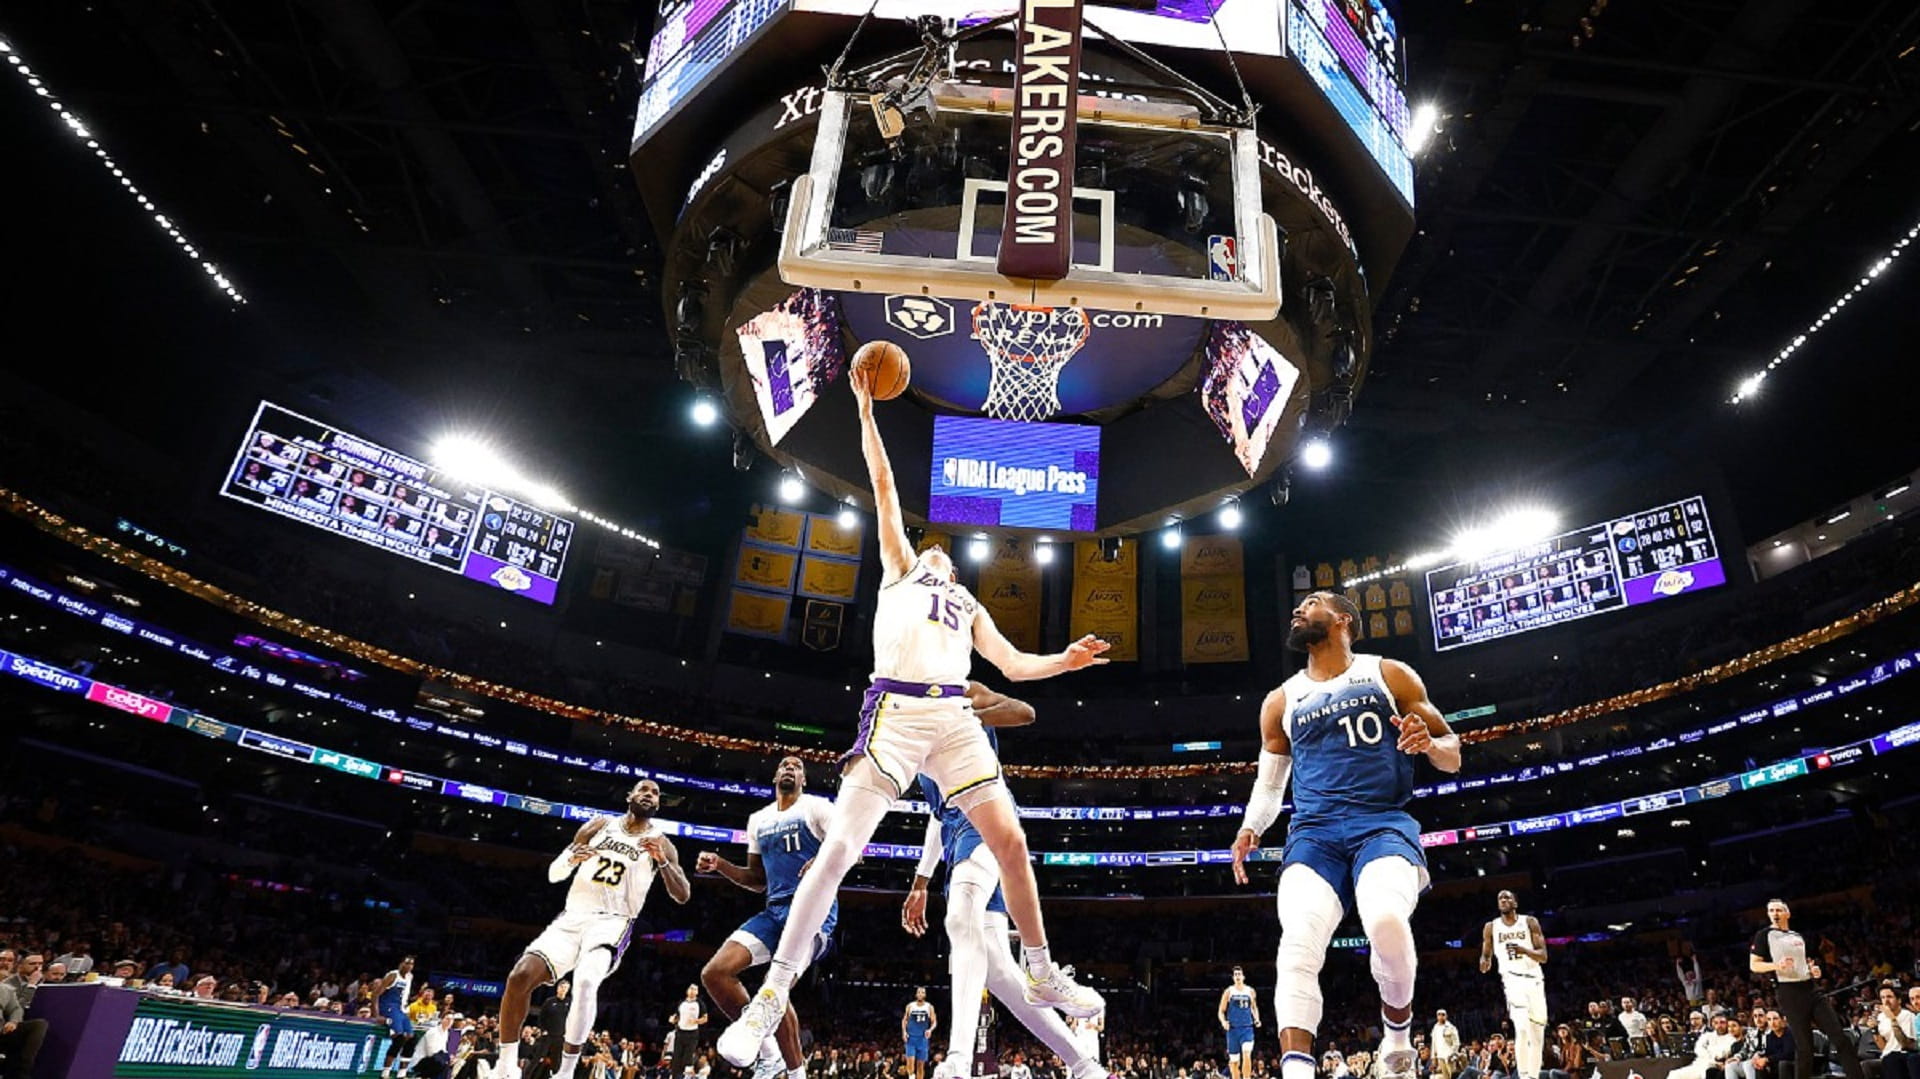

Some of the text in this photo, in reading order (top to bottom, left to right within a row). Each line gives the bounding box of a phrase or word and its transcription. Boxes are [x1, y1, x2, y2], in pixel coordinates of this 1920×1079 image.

[1016, 0, 1075, 243] LAKERS.COM
[1256, 137, 1353, 249] rackers
[957, 458, 1087, 495] NBA League Pass
[264, 496, 338, 529] MINNESOTA
[340, 522, 433, 560] TIMBERWOLVES
[1659, 511, 1671, 523] 22
[927, 593, 962, 631] 15
[1518, 603, 1595, 628] TIMBERWOLVES
[11, 657, 82, 690] Spectrum
[106, 689, 158, 714] boldyn
[1296, 695, 1379, 726] MINNESOTA
[1338, 711, 1383, 748] 10
[1829, 748, 1863, 762] TOYOTA
[403, 774, 433, 788] TOYOTA
[1515, 818, 1562, 833] Spectrum
[595, 836, 640, 862] LAKERS
[783, 832, 801, 852] 11
[592, 856, 627, 886] 23
[1108, 853, 1144, 864] DELTA
[118, 1016, 246, 1067] NBATickets.com
[268, 1029, 357, 1071] NBATickets.com
